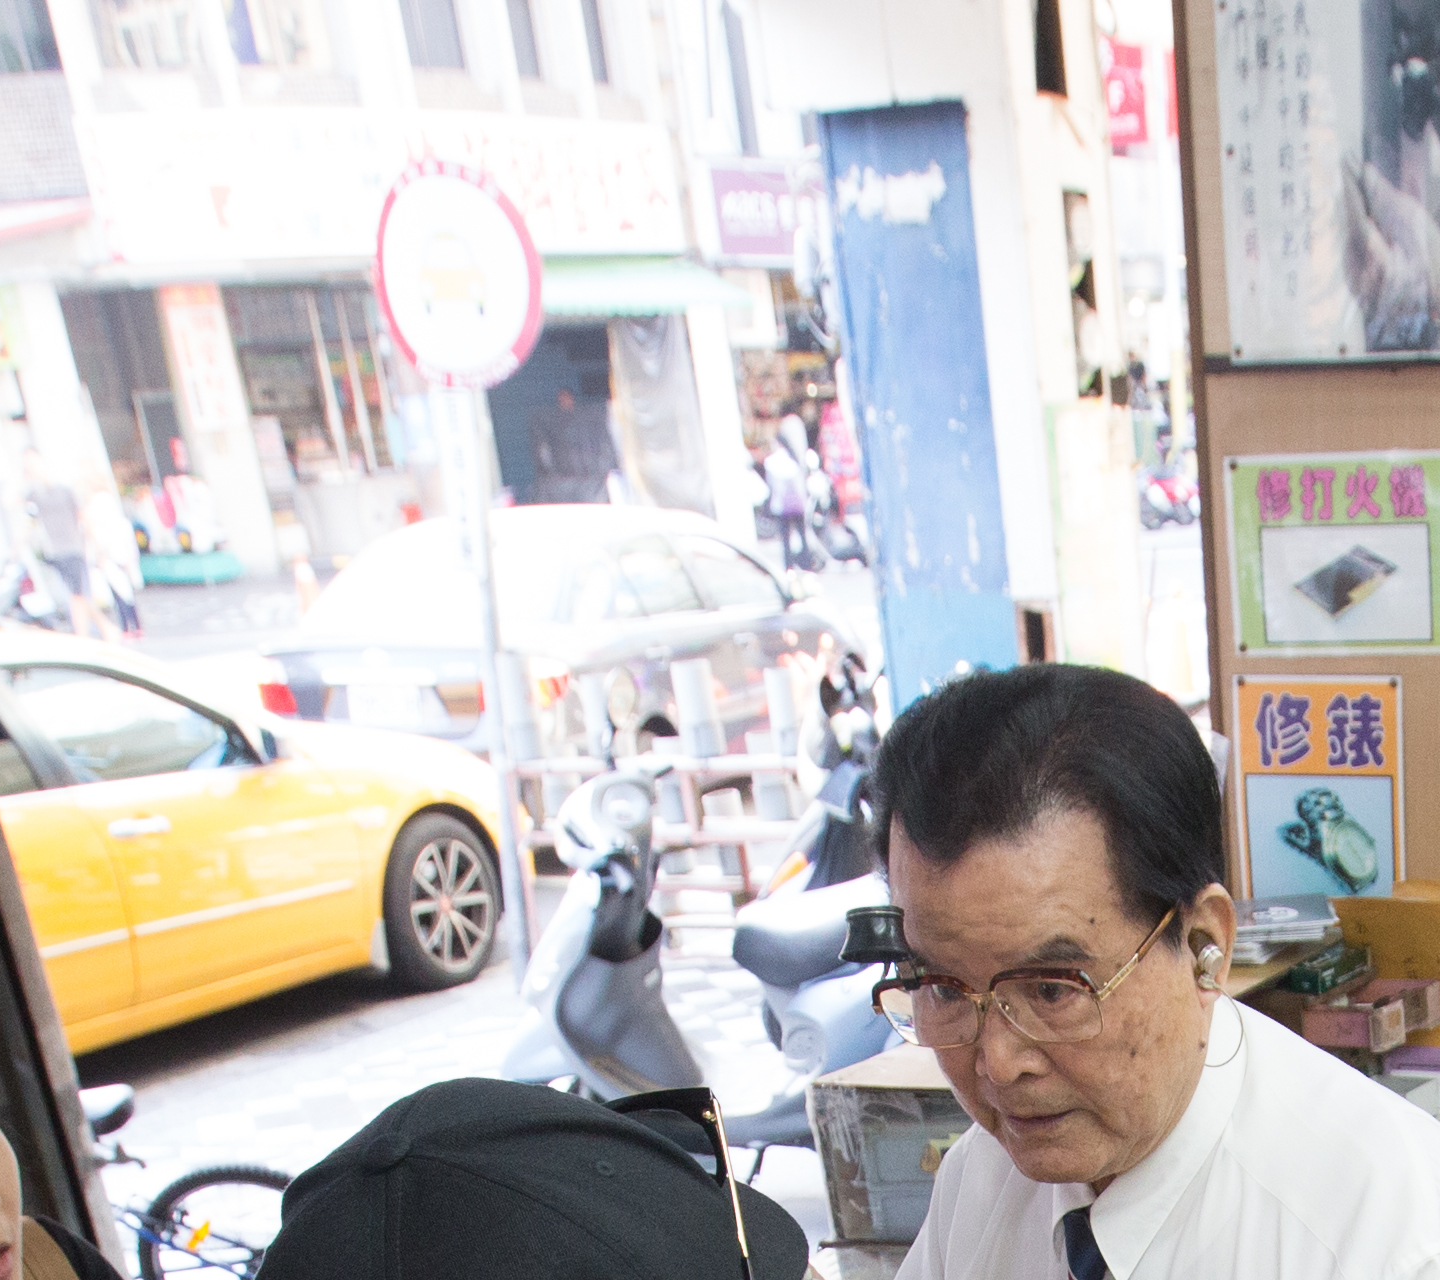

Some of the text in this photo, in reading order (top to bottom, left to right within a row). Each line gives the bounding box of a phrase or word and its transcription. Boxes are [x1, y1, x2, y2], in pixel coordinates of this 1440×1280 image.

[1255, 463, 1428, 521] 修打火機
[1255, 692, 1386, 768] 修錶
